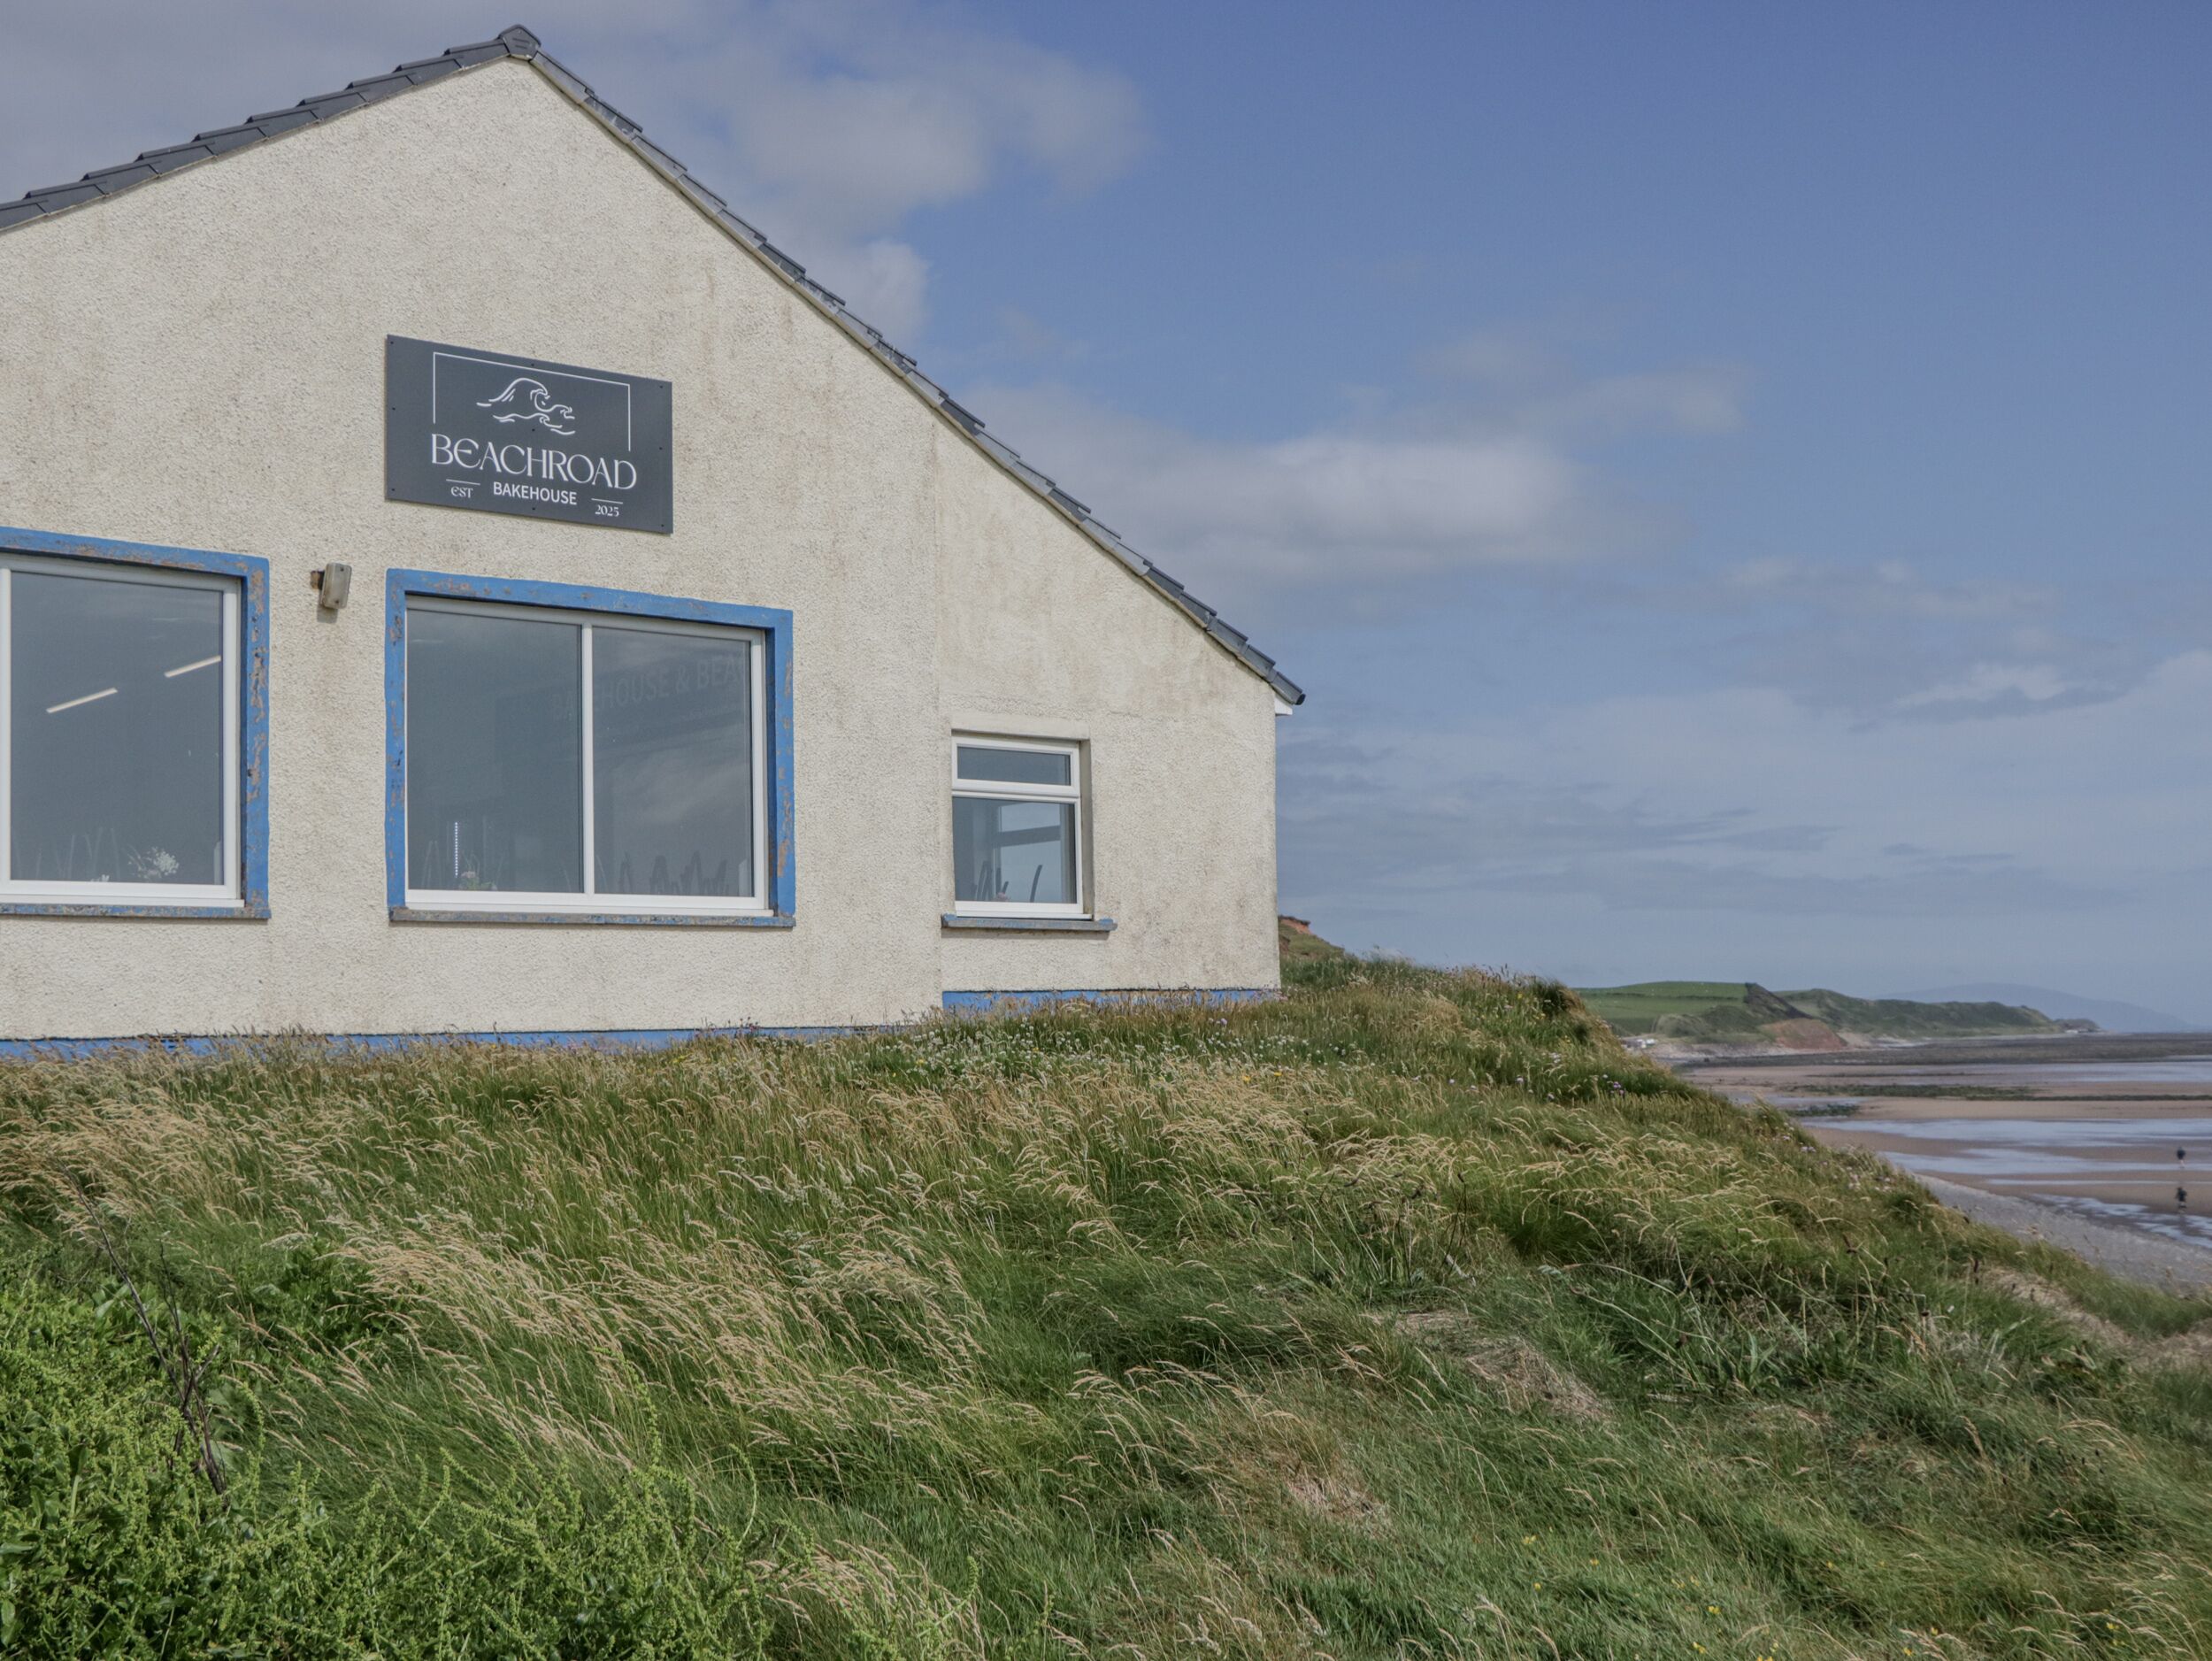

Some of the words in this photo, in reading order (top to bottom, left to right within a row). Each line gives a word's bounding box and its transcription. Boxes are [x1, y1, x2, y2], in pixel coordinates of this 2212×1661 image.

[431, 433, 637, 490] BEACHROAD
[450, 486, 473, 498] EST
[493, 481, 577, 505] BAKEHOUSE
[595, 504, 619, 517] 2025
